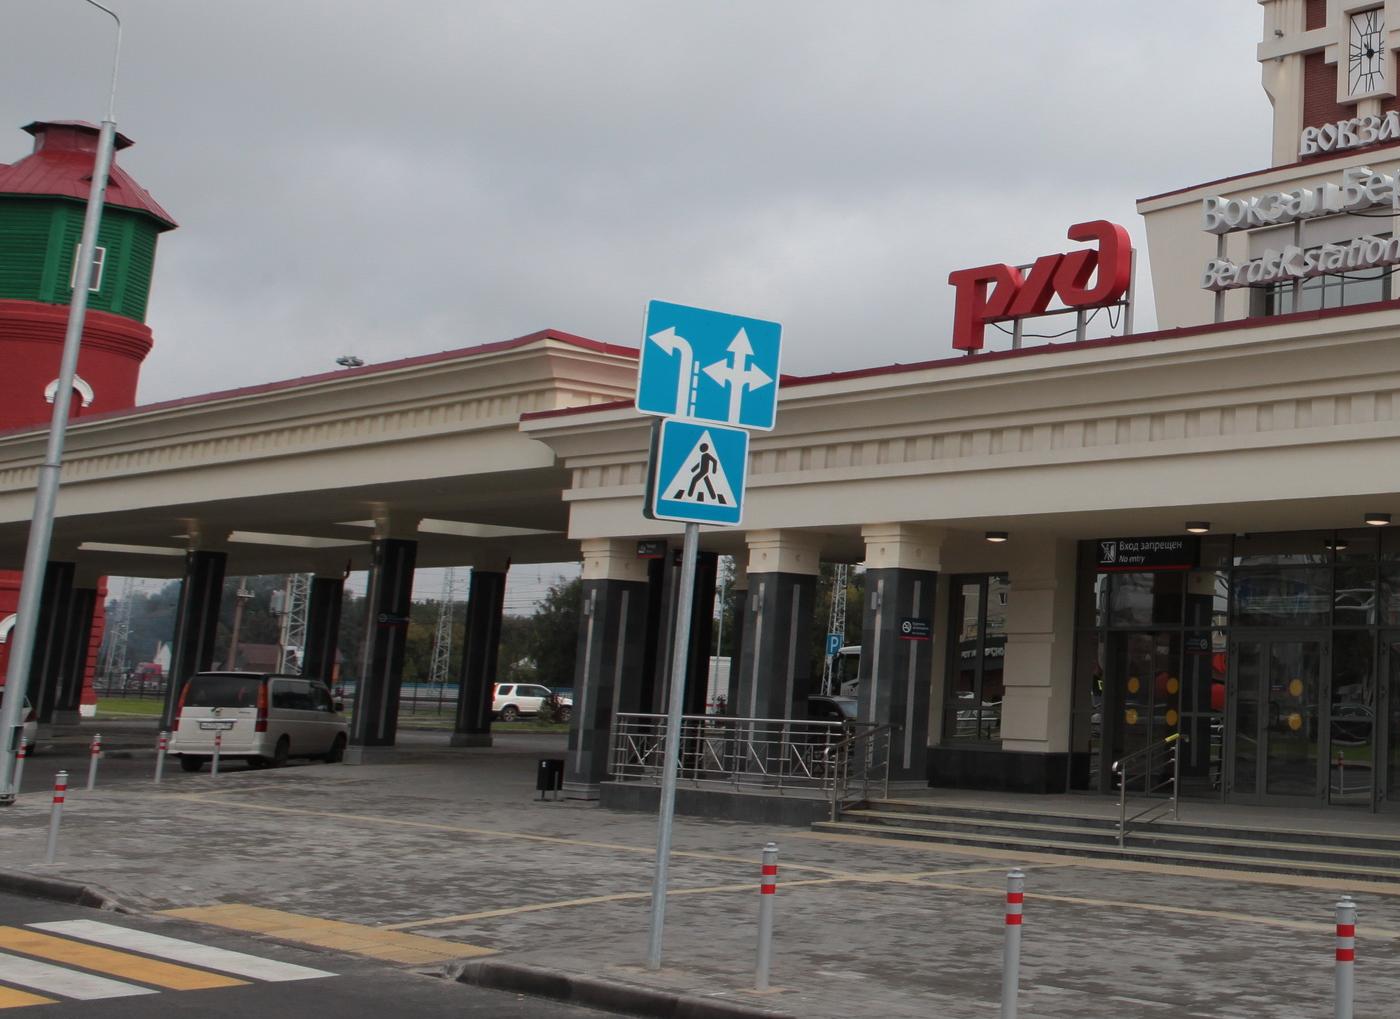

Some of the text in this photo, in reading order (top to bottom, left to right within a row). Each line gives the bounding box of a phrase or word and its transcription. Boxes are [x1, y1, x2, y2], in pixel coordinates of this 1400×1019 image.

[1201, 181, 1341, 234] Вокзал
[1201, 246, 1304, 291] Berdsk
[1119, 541, 1183, 552] Вход запрещен
[831, 636, 839, 653] P
